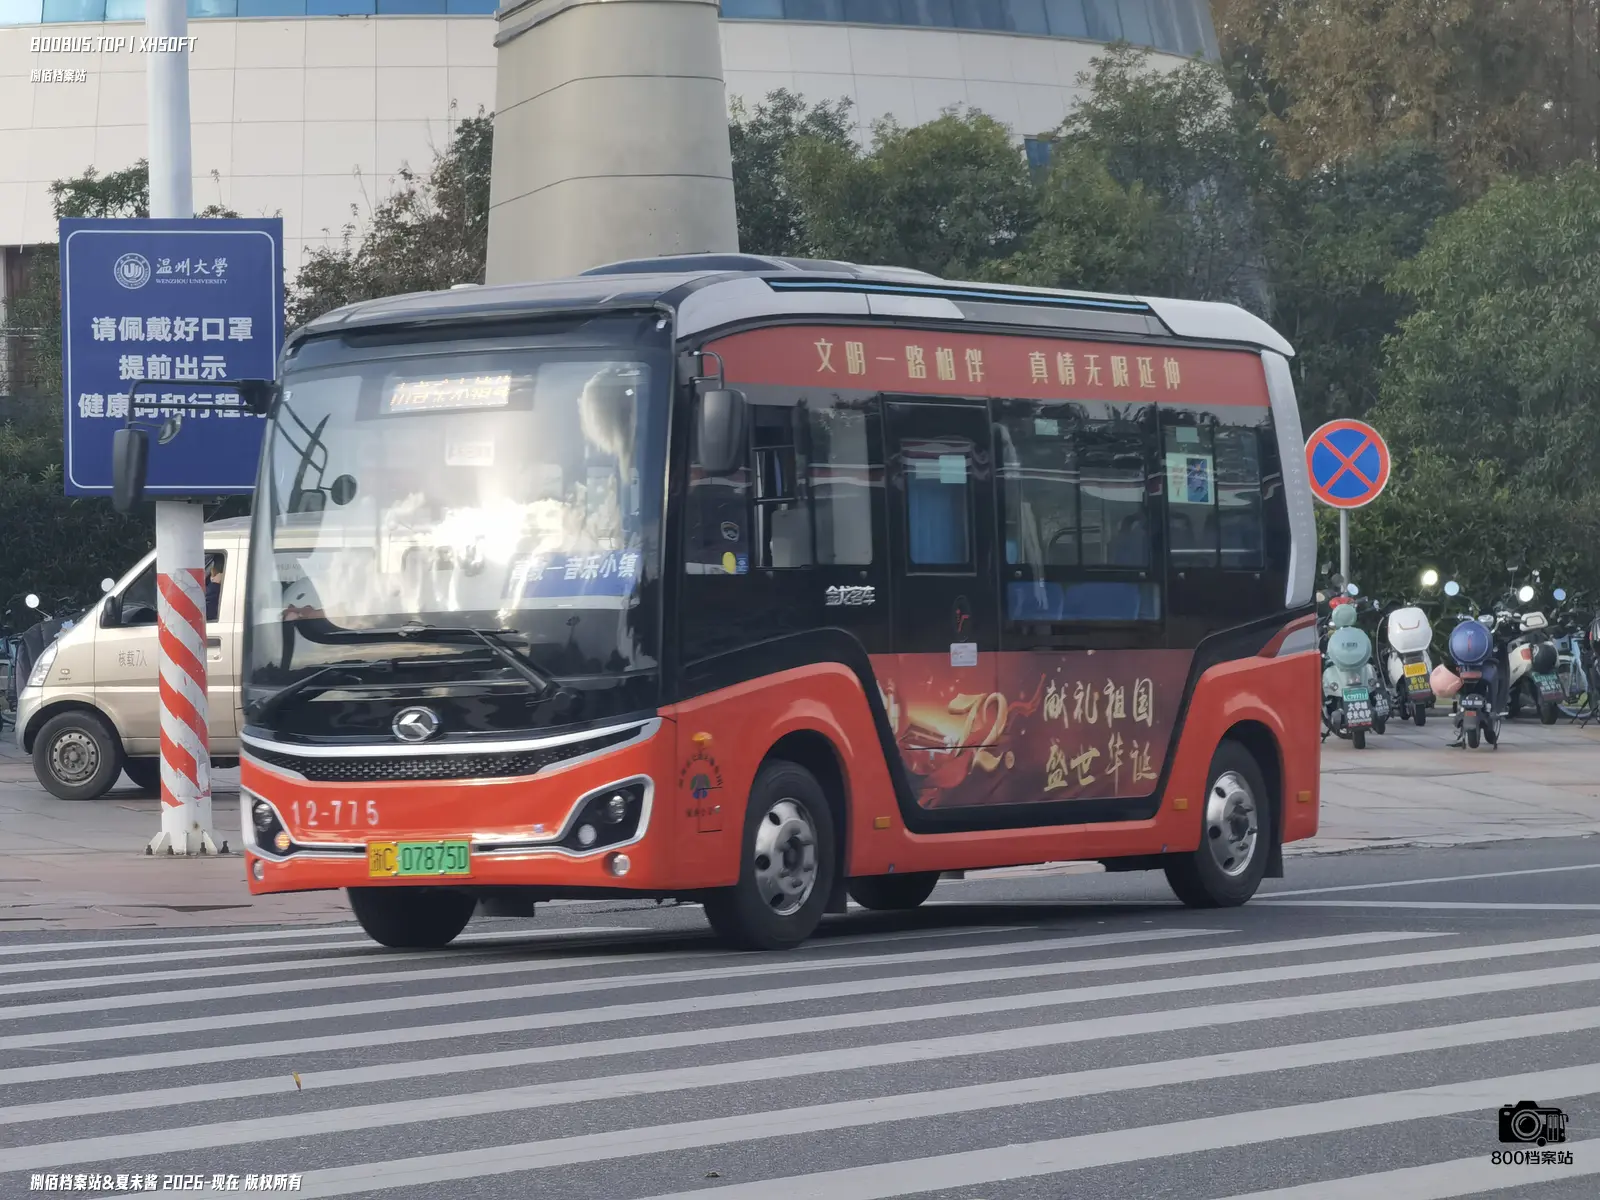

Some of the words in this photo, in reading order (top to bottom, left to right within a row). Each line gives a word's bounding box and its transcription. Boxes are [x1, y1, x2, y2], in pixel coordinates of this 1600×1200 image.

[156, 257, 228, 277] 温州大學
[91, 316, 253, 342] 请佩戴好口罩
[119, 354, 227, 380] 提前出示
[814, 337, 986, 383] 文明一路相伴
[1028, 350, 1182, 391] 真情无限延伸
[1044, 677, 1154, 728] 献礼祖国
[1043, 732, 1158, 794] 盛世华诞
[290, 800, 380, 827] 12-775
